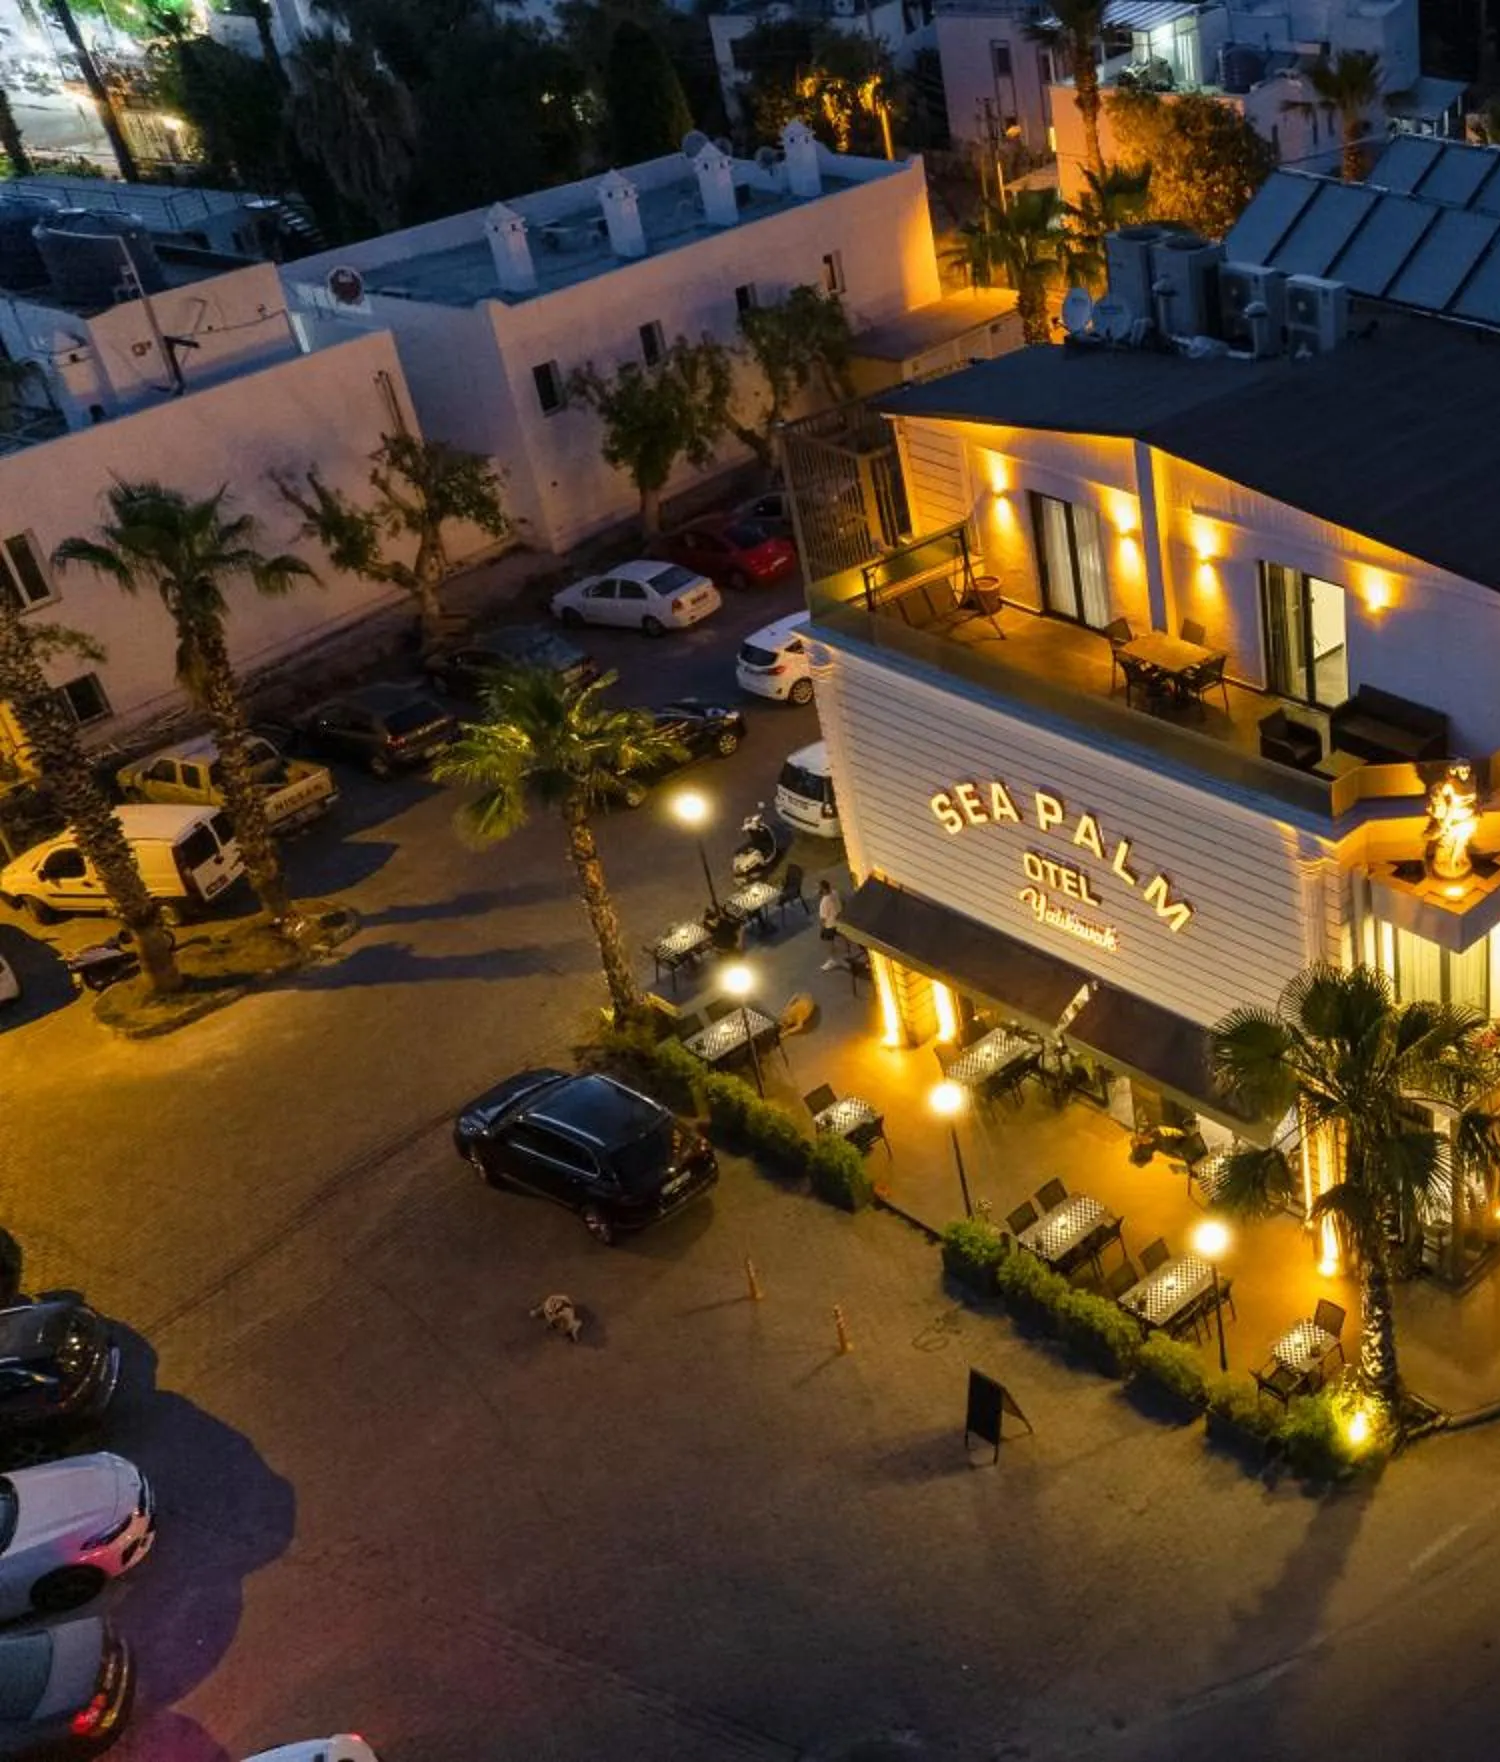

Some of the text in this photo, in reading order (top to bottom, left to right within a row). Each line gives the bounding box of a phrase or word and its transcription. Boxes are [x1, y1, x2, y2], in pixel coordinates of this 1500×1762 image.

[930, 781, 1193, 932] SEA PALM
[1023, 851, 1099, 906] OTEL
